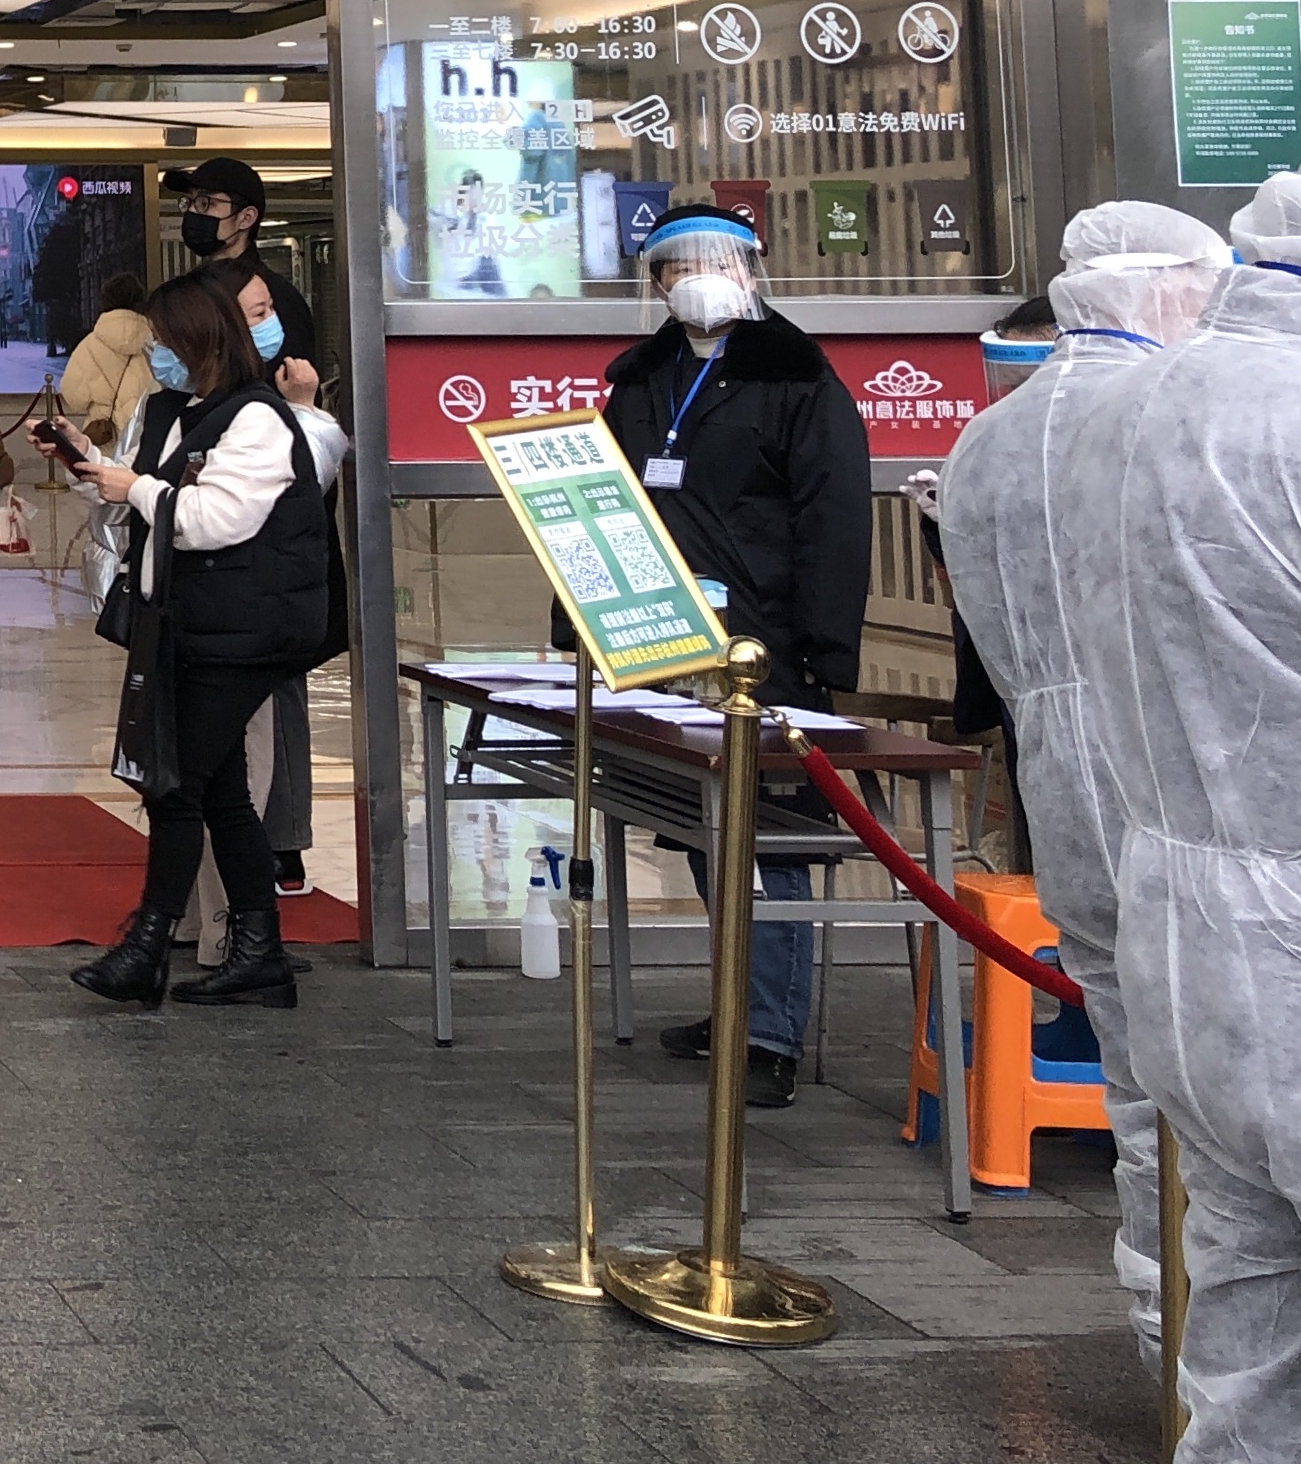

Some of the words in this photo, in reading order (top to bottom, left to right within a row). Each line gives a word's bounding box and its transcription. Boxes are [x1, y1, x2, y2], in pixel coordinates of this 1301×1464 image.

[428, 16, 513, 36] 一至二楼
[770, 112, 966, 134] 选择01意法免费WiFi
[81, 180, 132, 195] 西瓜视频
